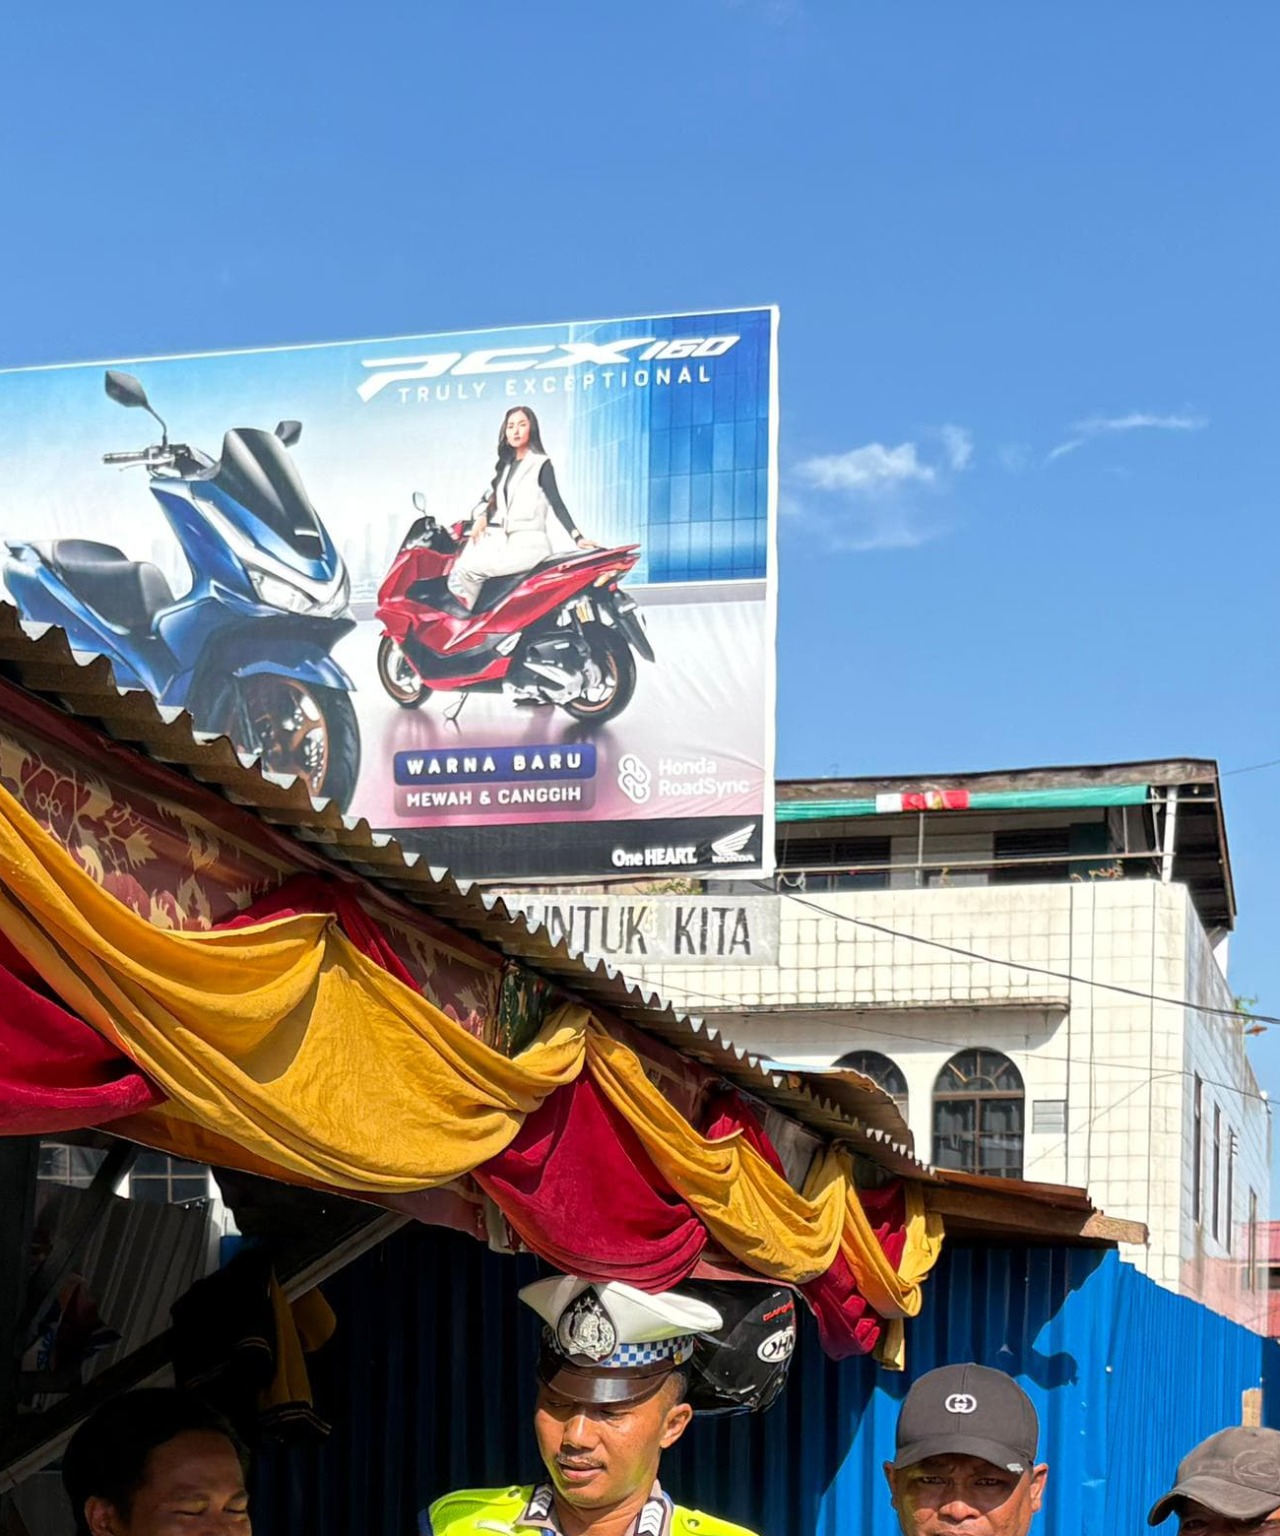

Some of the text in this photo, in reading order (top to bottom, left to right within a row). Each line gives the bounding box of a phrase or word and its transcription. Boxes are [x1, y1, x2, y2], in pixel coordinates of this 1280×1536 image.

[356, 335, 741, 402] PCX 160
[398, 364, 712, 405] TRULY EXCEPTIONAL
[406, 752, 582, 776] WARNA BARU
[660, 757, 717, 778] Honda
[406, 786, 582, 808] MEWAH & CANGGIH
[659, 778, 751, 801] RoadSync
[611, 846, 644, 868] One
[674, 905, 751, 955] KITA
